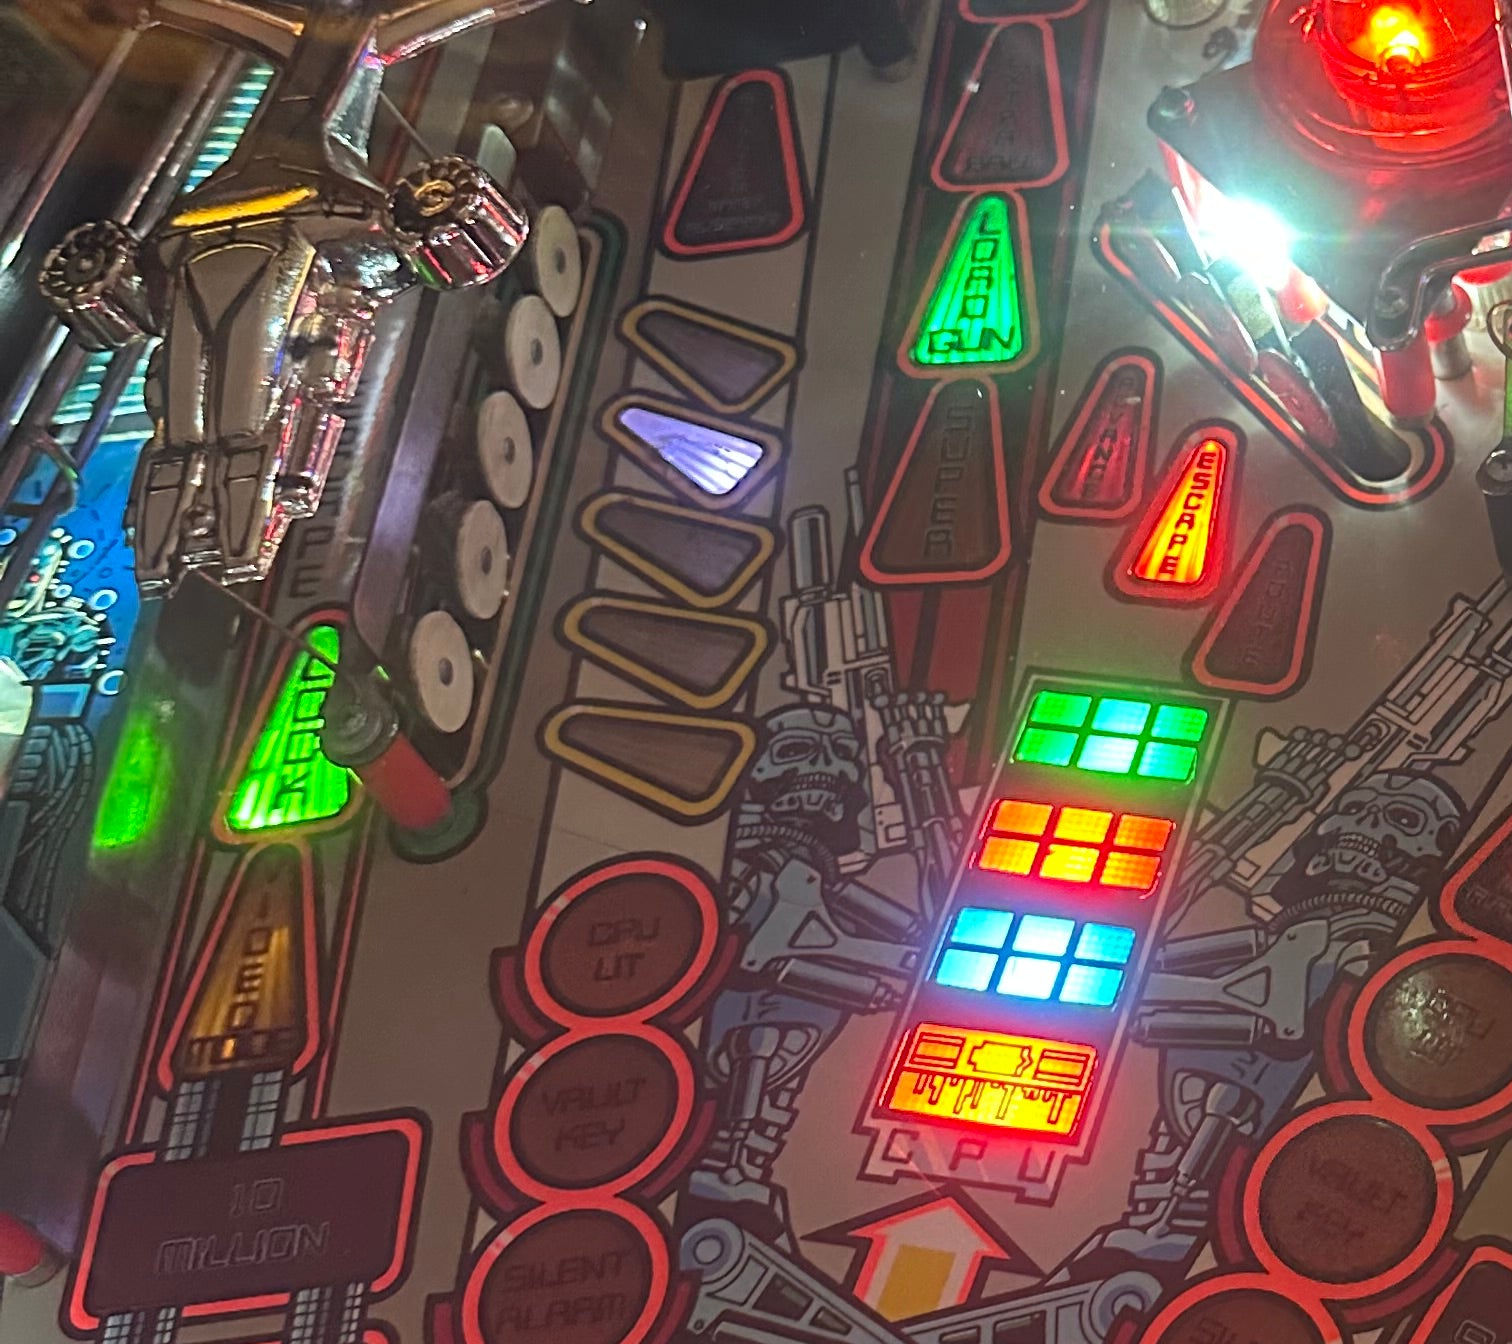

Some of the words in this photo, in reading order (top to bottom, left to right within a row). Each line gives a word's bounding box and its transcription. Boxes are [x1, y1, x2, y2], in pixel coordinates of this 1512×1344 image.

[926, 327, 1016, 358] GUN
[923, 405, 975, 558] SUPER
[1158, 452, 1217, 575] ESCAPE
[587, 915, 662, 948] CPU
[594, 952, 646, 982] LIT
[881, 1126, 1057, 1182] CPU
[229, 1177, 283, 1218] 10
[155, 1221, 330, 1276] MILLION
[503, 1248, 632, 1296] SILENT
